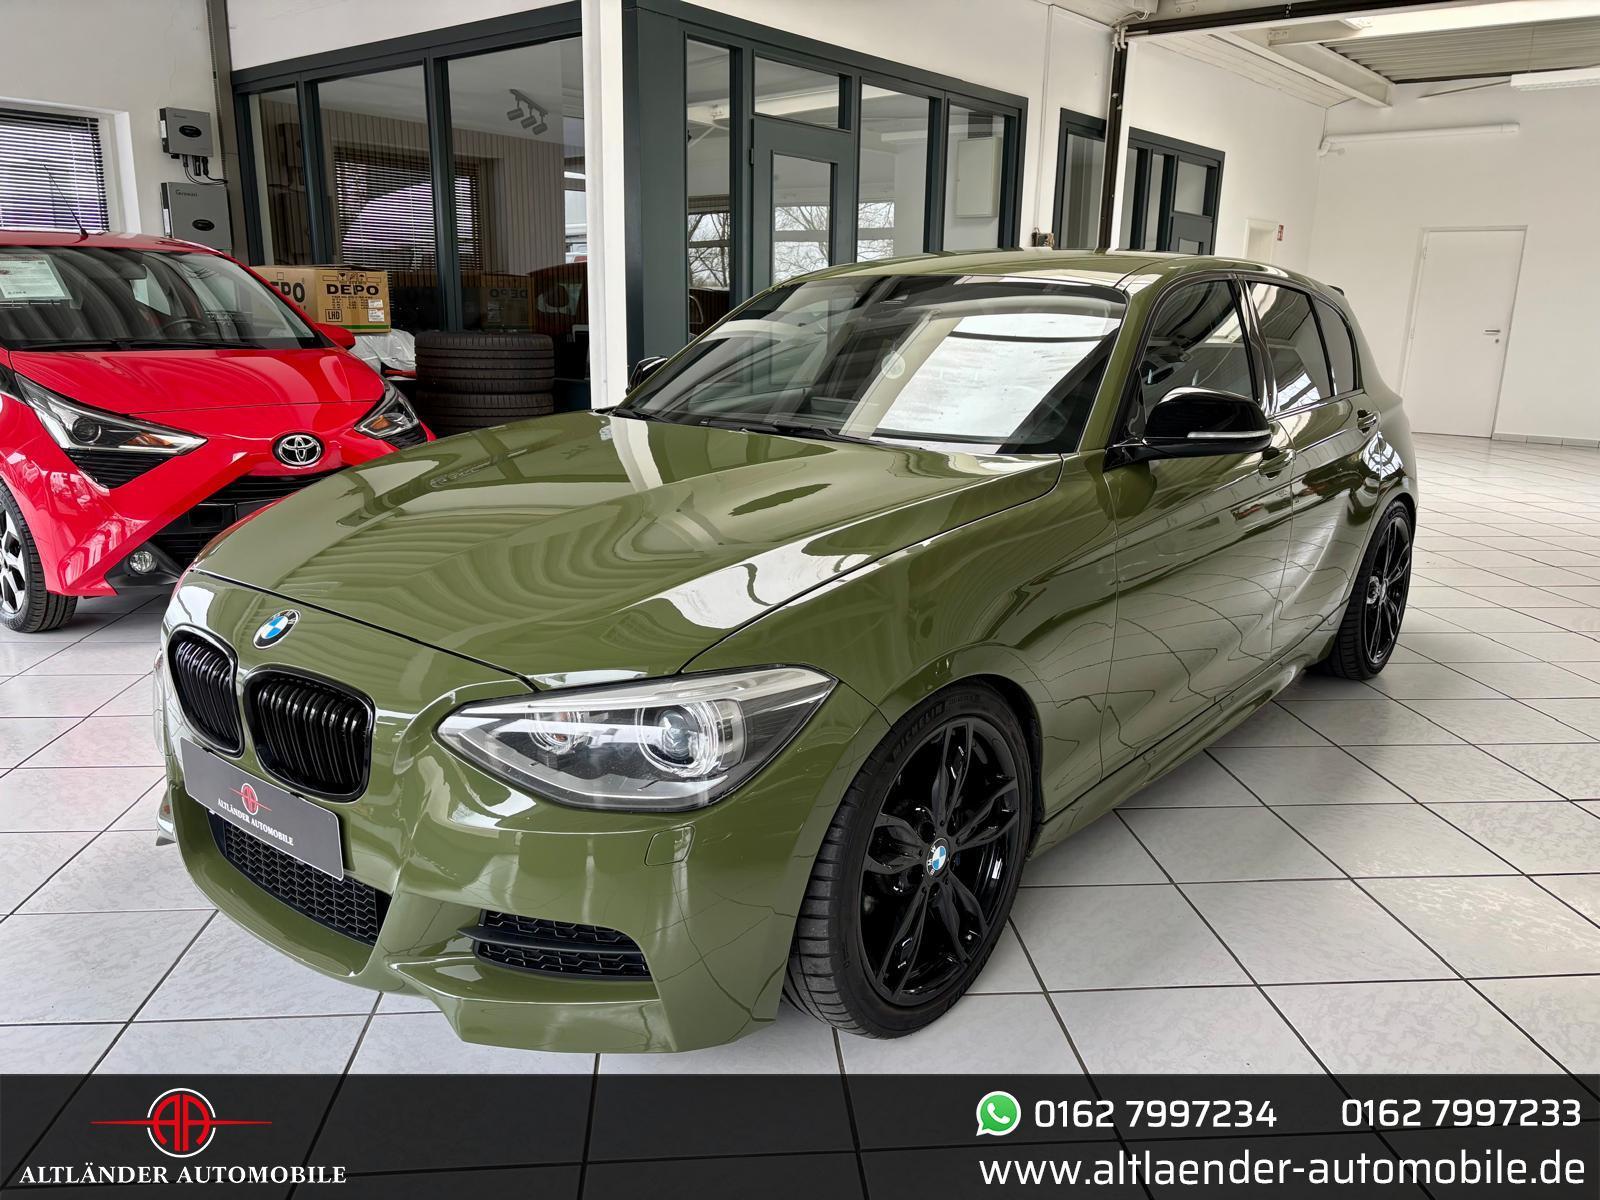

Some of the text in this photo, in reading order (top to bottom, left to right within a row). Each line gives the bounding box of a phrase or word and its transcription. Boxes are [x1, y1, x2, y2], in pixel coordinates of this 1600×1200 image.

[326, 283, 380, 296] DEPO
[328, 311, 340, 320] LHD
[218, 798, 294, 846] ALTLÄNDER AUTOMOBILE
